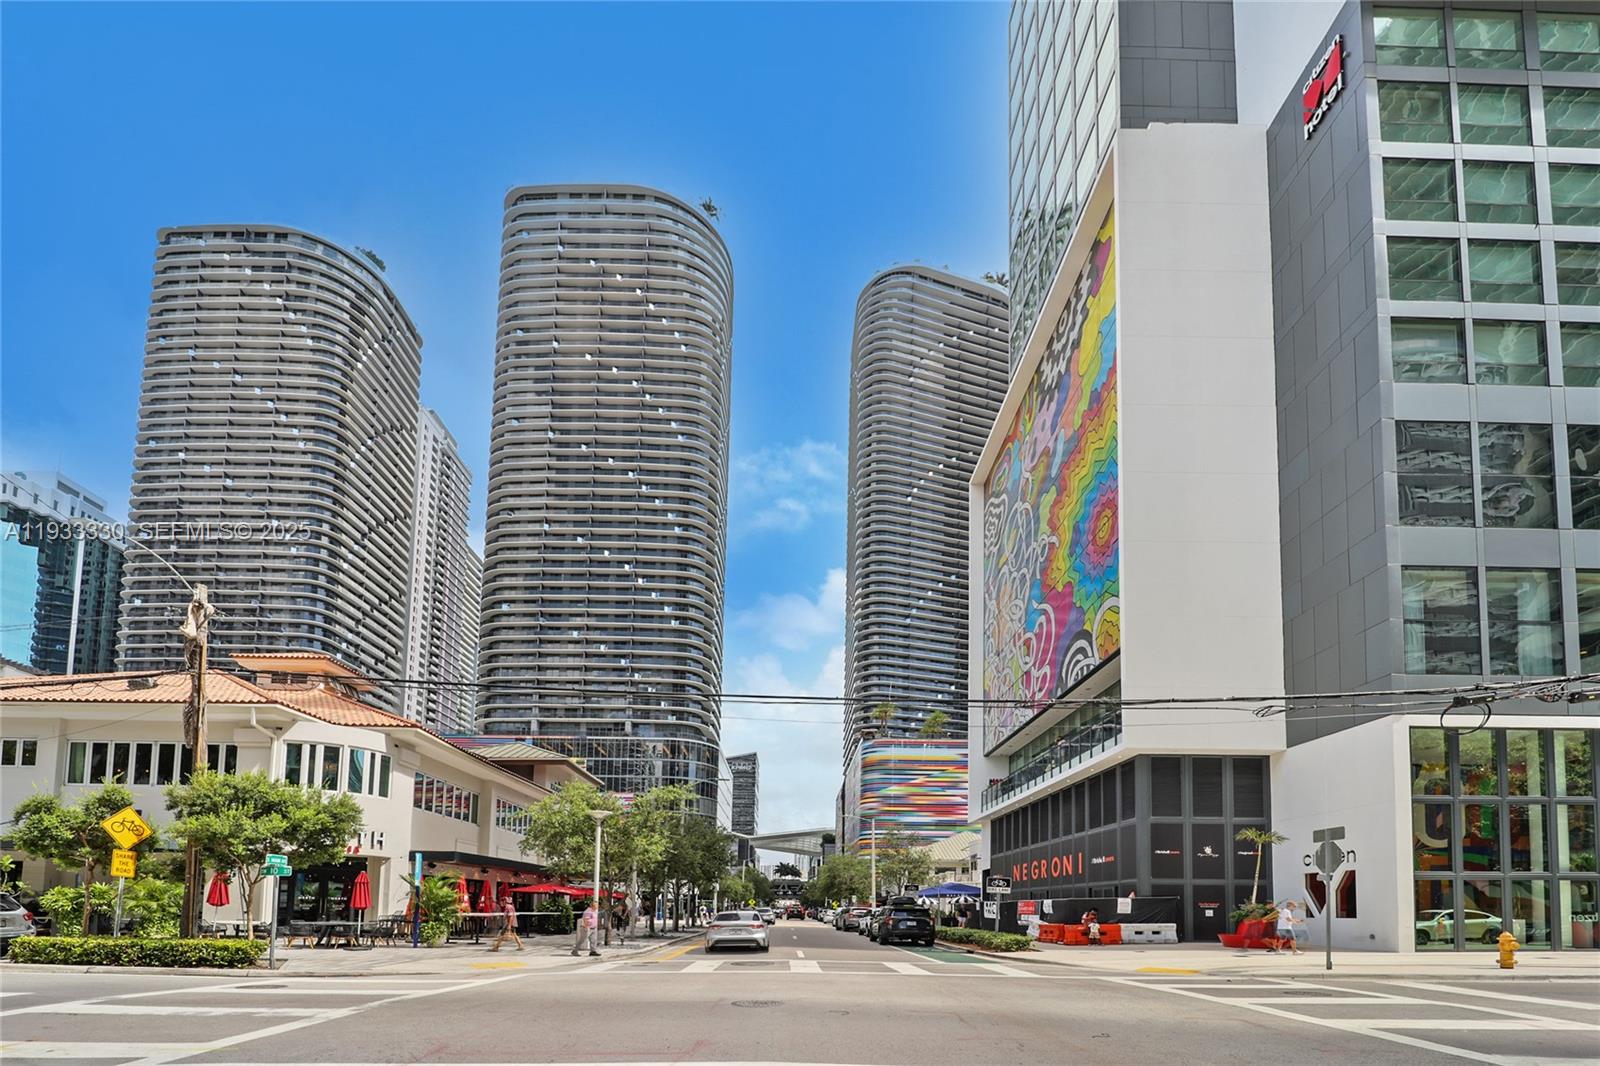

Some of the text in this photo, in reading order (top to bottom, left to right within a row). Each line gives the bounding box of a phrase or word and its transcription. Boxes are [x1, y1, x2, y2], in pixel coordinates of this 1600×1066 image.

[1303, 72, 1343, 141] hotel
[115, 852, 134, 860] SHARE
[270, 867, 279, 875] 10
[1013, 852, 1083, 881] NEGRONI
